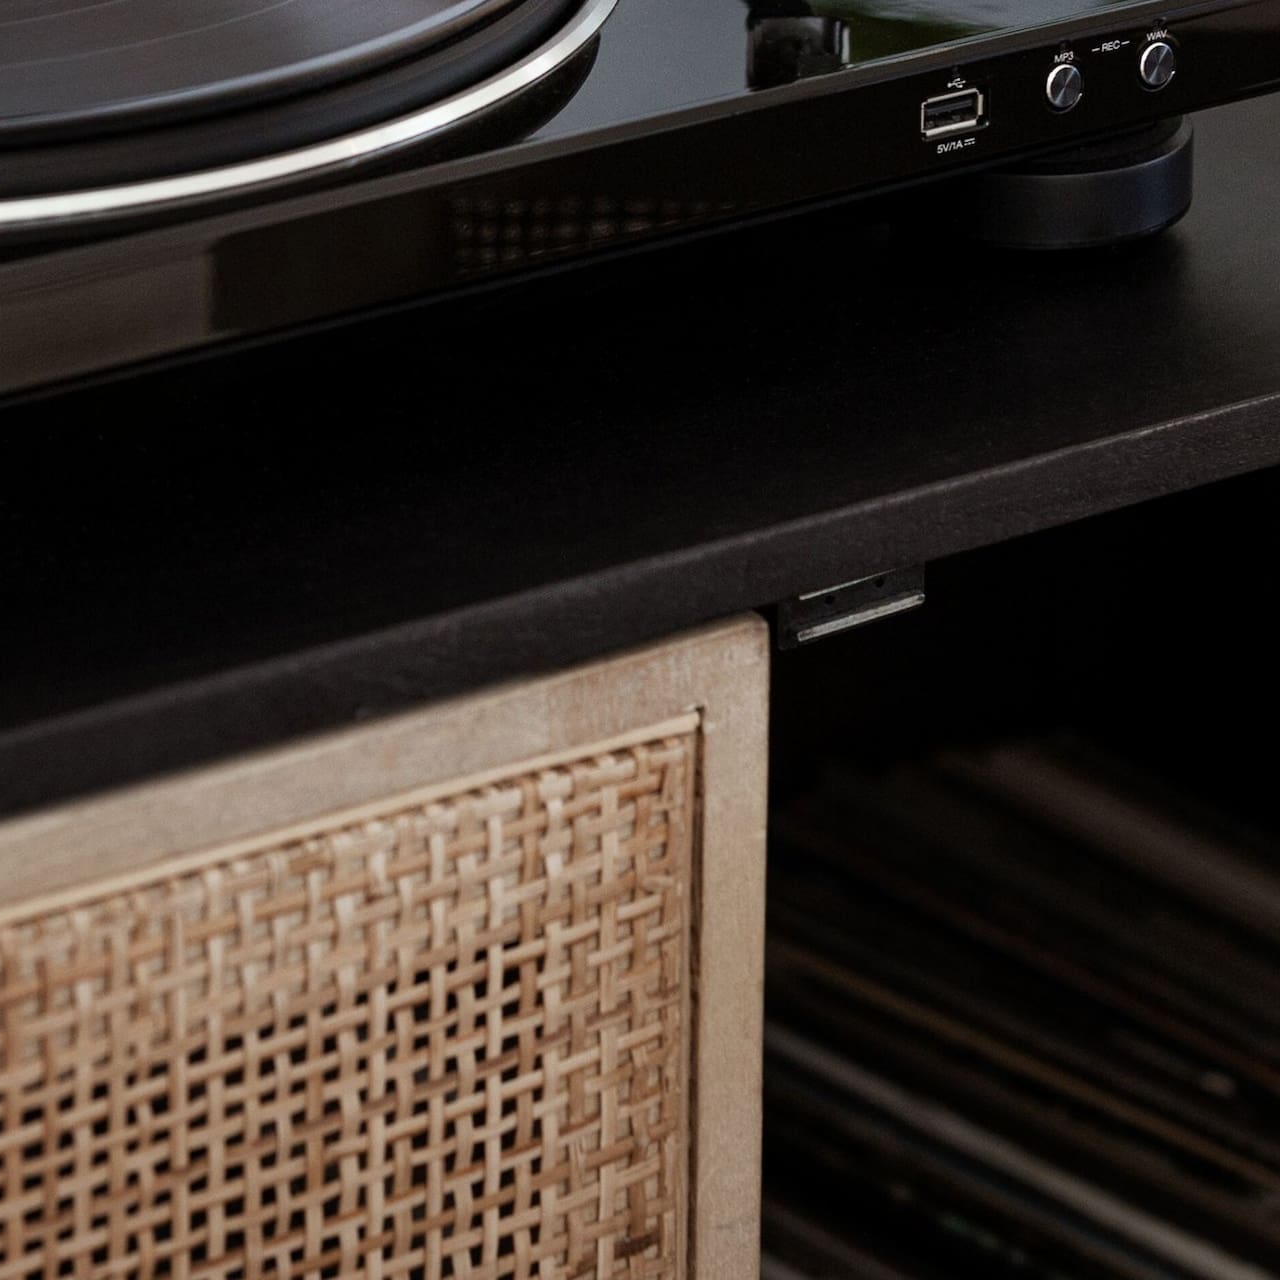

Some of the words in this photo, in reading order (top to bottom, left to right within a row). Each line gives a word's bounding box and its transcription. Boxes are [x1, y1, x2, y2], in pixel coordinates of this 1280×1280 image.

[1146, 29, 1168, 41] WAV
[1101, 40, 1121, 52] REC
[1054, 51, 1074, 63] MP3
[937, 140, 963, 154] 5V/1A
